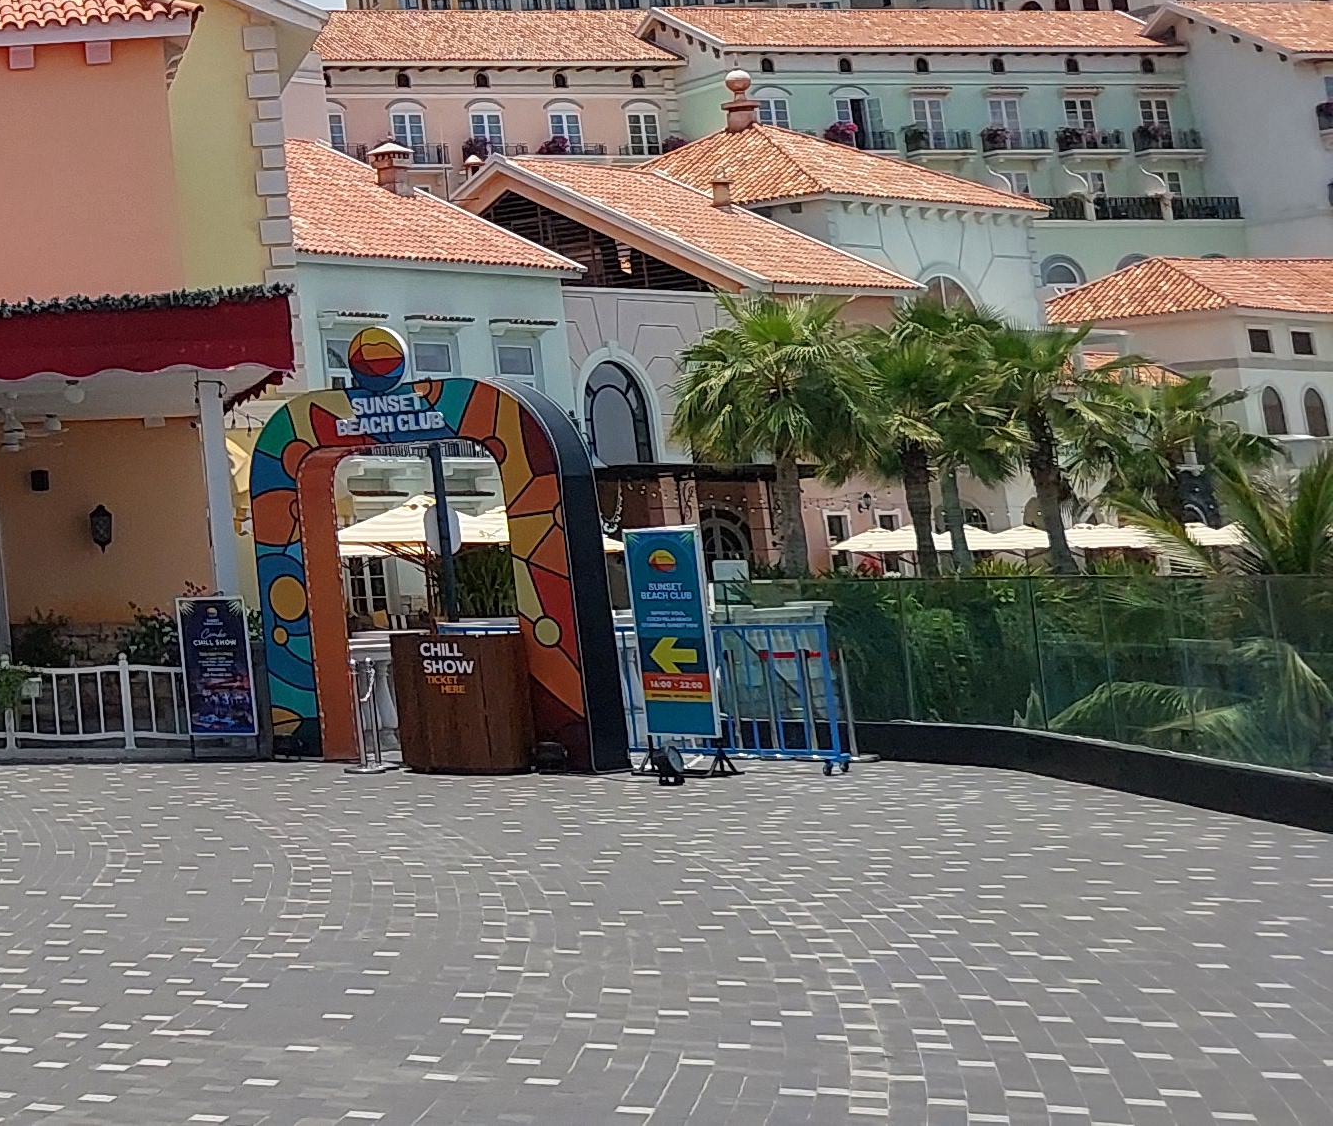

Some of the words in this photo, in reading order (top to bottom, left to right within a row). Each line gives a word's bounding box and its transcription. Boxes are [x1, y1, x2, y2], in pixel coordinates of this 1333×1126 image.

[351, 392, 424, 416] SUNSET
[336, 415, 395, 437] BEACH
[396, 412, 446, 431] CLUB
[648, 582, 682, 592] SUNSET
[640, 591, 669, 601] BEACH
[670, 591, 693, 600] CLUB
[419, 642, 464, 657] CHILL
[422, 659, 475, 674] SHOW
[425, 675, 458, 685] TICKET
[440, 685, 466, 694] HERE
